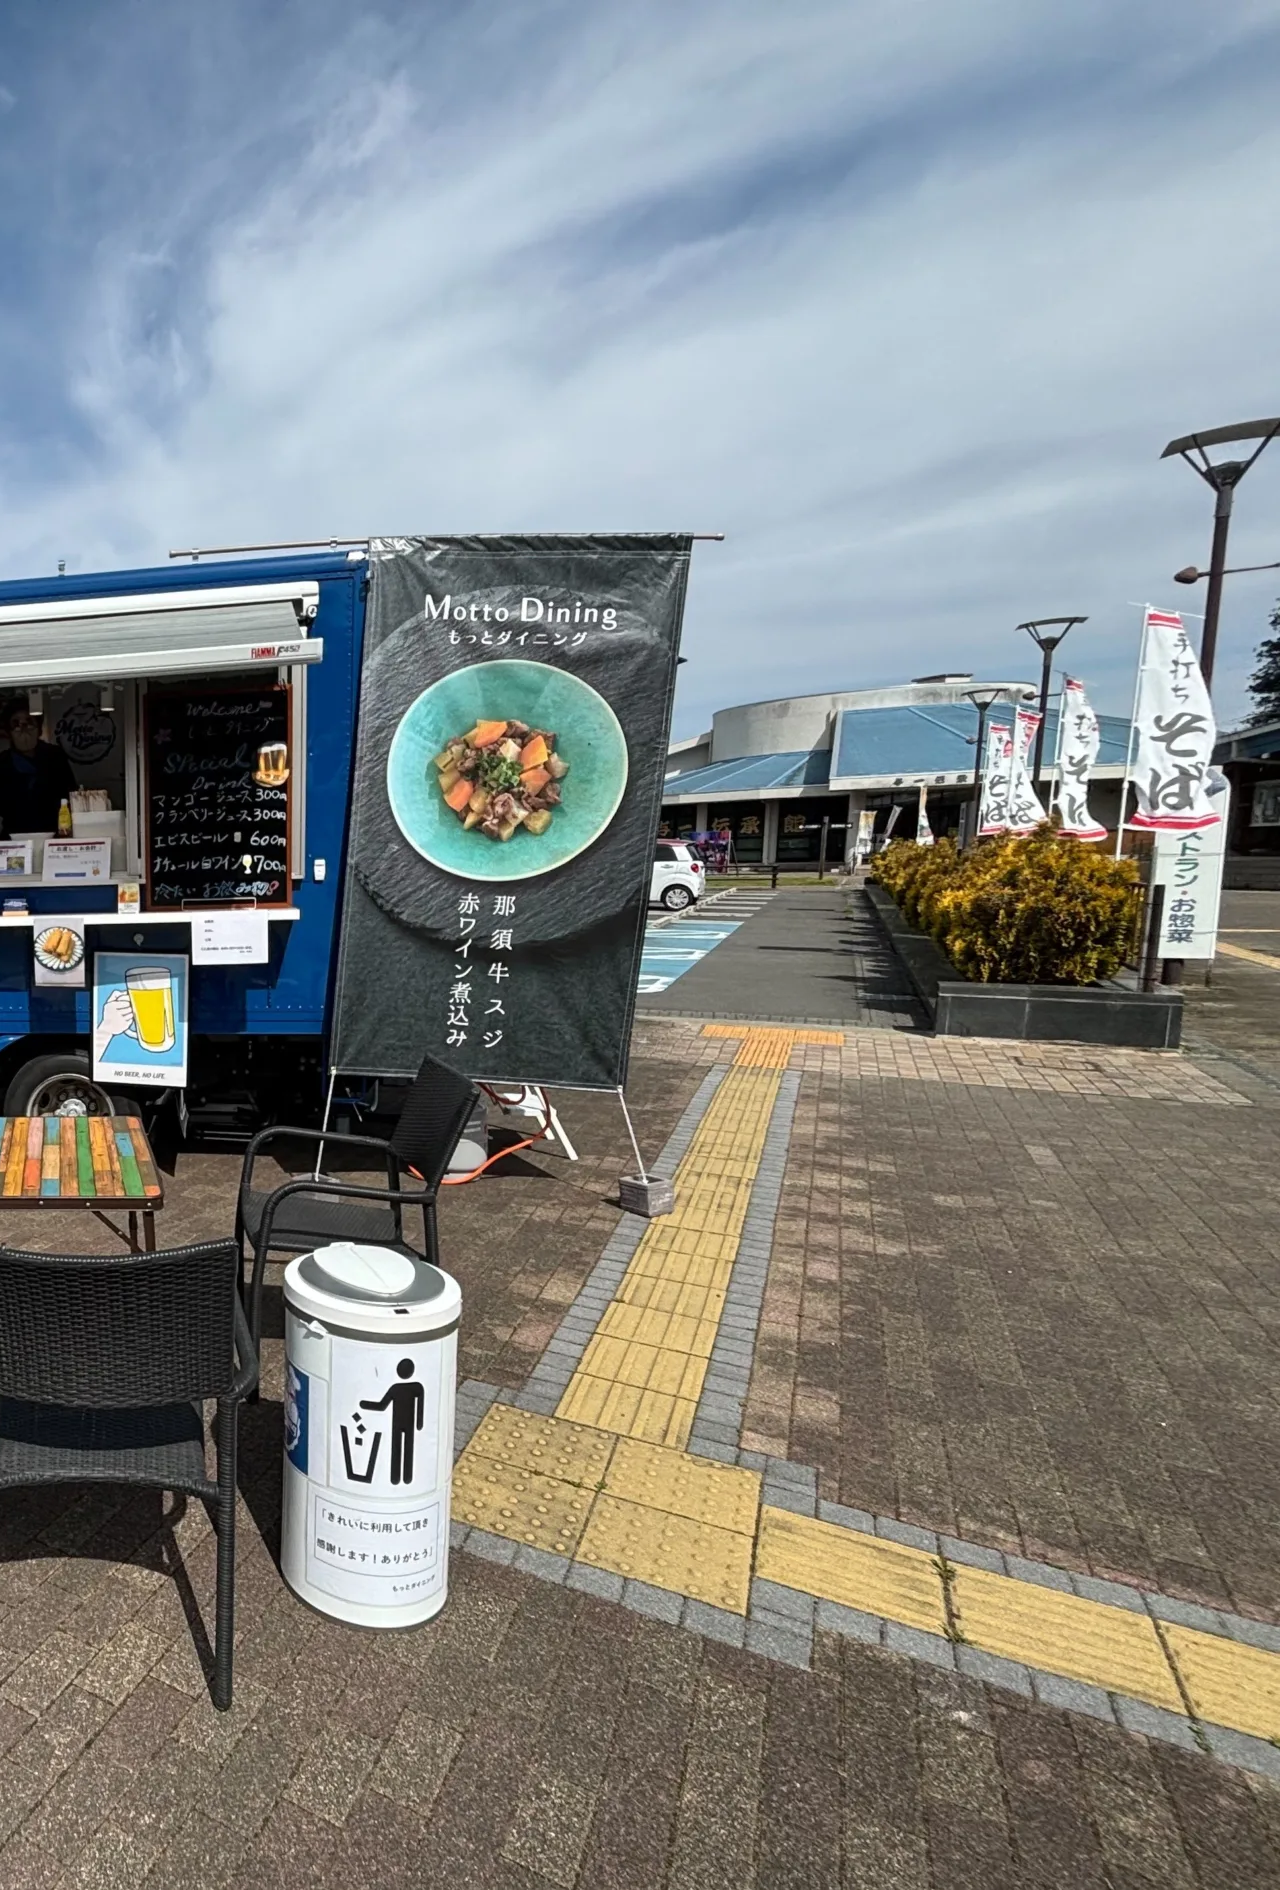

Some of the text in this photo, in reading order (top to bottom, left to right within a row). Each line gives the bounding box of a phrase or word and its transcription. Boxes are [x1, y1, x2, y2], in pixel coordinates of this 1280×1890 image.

[424, 594, 618, 631] Motto Dining
[448, 630, 588, 646] もっとダイニング
[251, 646, 276, 658] FIAMMA
[1149, 633, 1208, 811] 手打ちそば
[191, 770, 253, 790] Drink
[255, 788, 287, 801] 300円
[154, 806, 287, 824] クランベリージュース 300円
[154, 830, 287, 848] エビスビール 600円
[253, 855, 287, 874] 700円
[446, 892, 480, 1047] 赤ワイン煮込み
[483, 895, 516, 1048] 那須牛スジ
[322, 1508, 428, 1533] 「きれいに利用して頂き
[317, 1538, 433, 1564] 感謝します!ありがとう」
[392, 1574, 435, 1592] もっとダイニング
